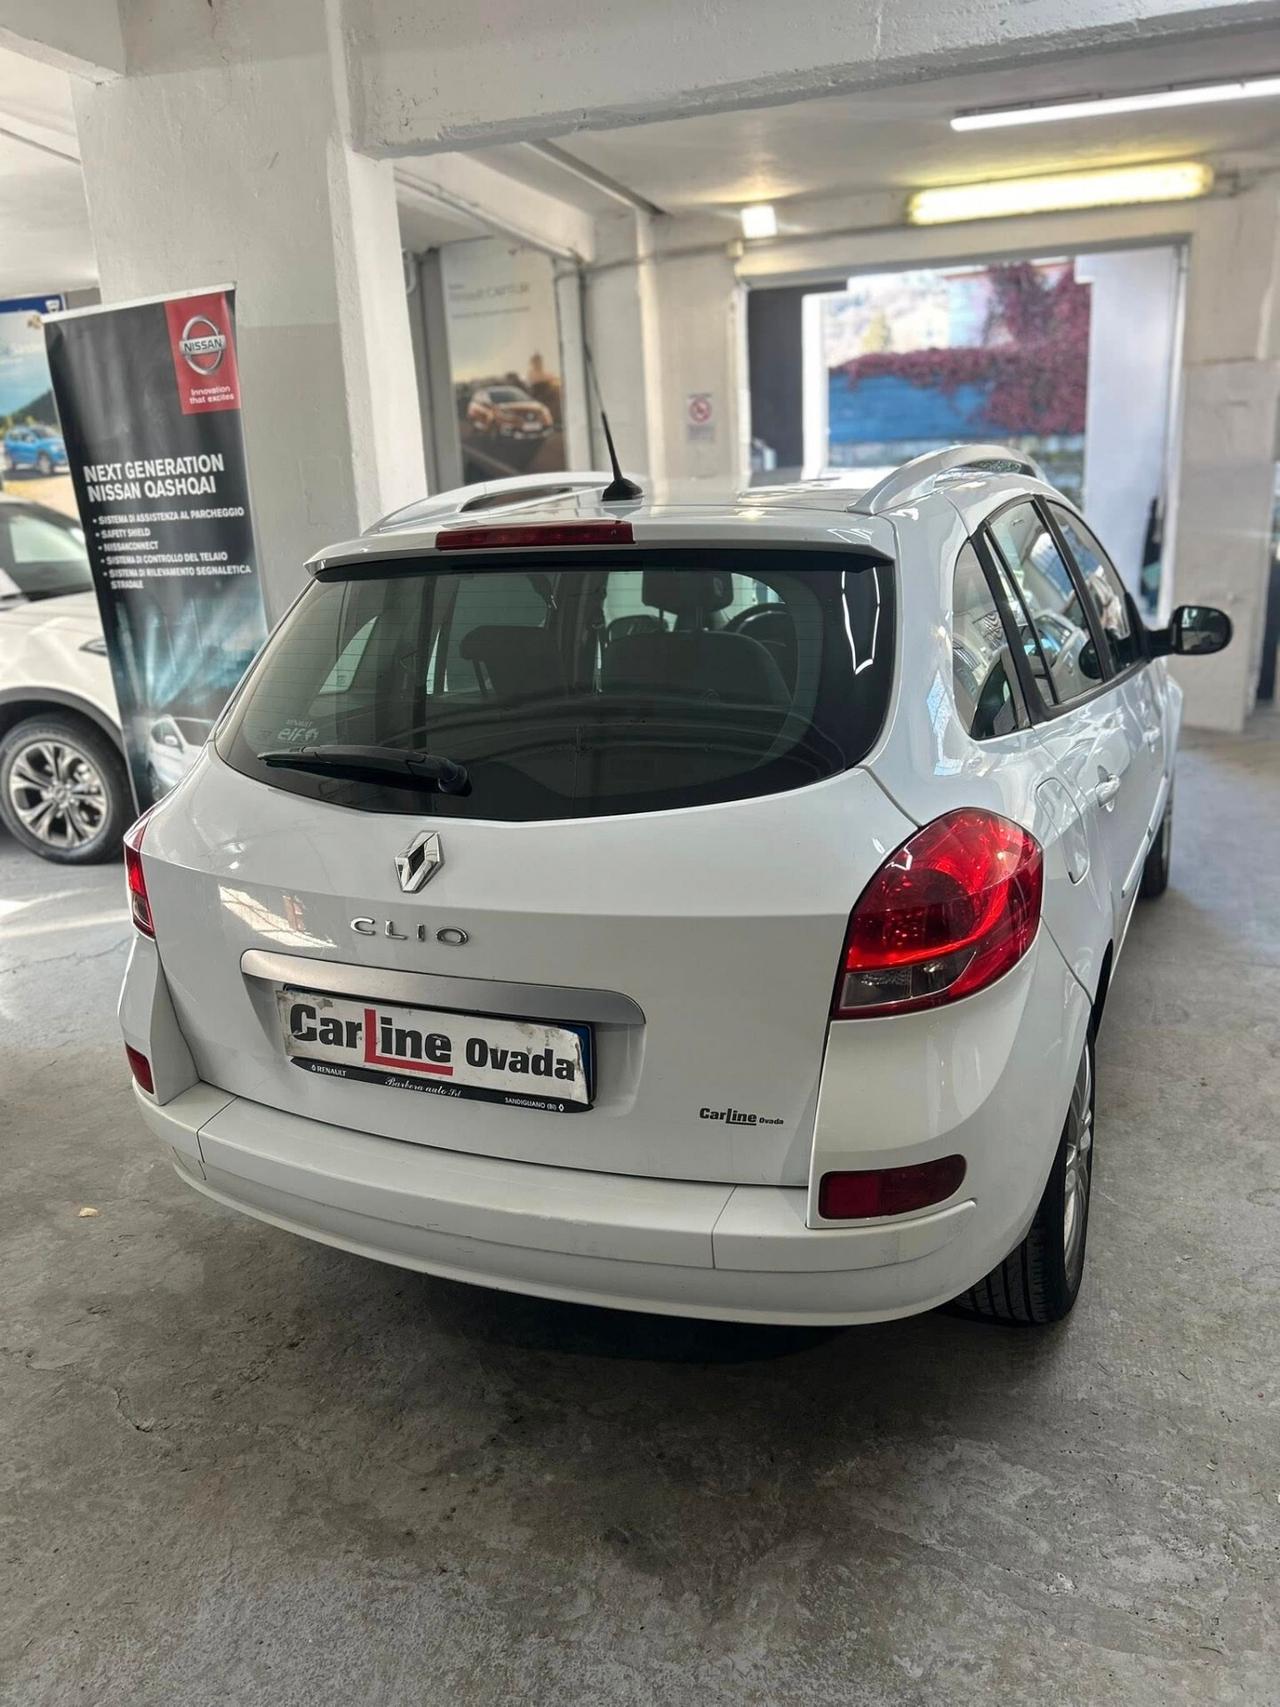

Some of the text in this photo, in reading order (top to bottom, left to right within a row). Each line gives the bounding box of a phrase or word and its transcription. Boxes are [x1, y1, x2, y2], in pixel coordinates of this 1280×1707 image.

[184, 339, 222, 352] NISSAN
[190, 386, 230, 395] Innovation
[207, 394, 234, 402] excites
[83, 453, 224, 483] NEXT GENERATION
[87, 475, 216, 502] NISSAN QASHQAI
[136, 511, 179, 523] ASSISTENZA
[180, 510, 190, 520] AL
[190, 507, 245, 519] PARCHEGGIO
[101, 528, 151, 539] SAFETY SHIELD
[103, 541, 159, 552] NISSANCONNECT
[143, 552, 184, 563] CONTROLLO
[184, 552, 199, 562] DEL
[199, 552, 228, 561] TELAIO
[146, 566, 194, 577] RILEVAMENTO
[195, 565, 252, 575] SEGNALETICA
[350, 916, 470, 947] CLIO
[465, 1036, 575, 1082] Ovada
[316, 1065, 347, 1077] RENAULT
[424, 1085, 446, 1095] auto
[504, 1096, 546, 1109] SANDIGLIANO
[759, 1116, 784, 1125] Ovada
